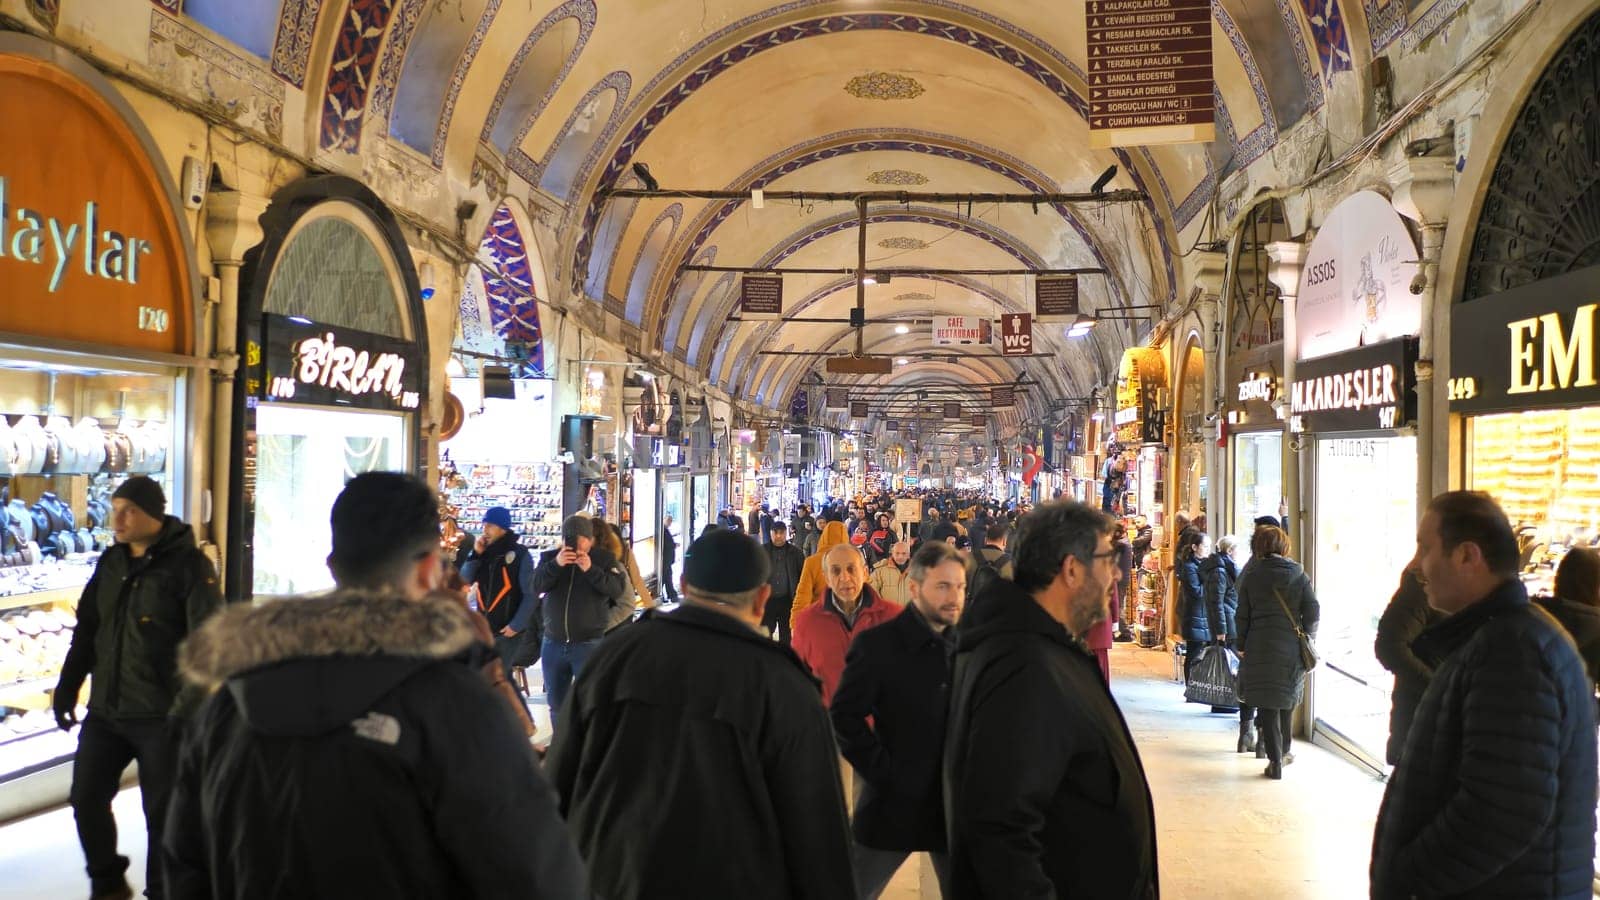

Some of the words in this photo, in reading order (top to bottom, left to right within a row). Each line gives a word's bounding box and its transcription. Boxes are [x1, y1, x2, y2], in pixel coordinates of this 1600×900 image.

[1104, 14, 1136, 26] CEVAHİR
[1136, 11, 1175, 23] BEDESTENİ
[1105, 29, 1135, 40] RESSAM
[1135, 26, 1181, 38] BASMACILAR
[1181, 26, 1194, 35] SK.
[1105, 43, 1149, 54] TAKKECİLER
[1150, 43, 1162, 52] SK.
[1106, 57, 1142, 69] TERZİBAŞI
[1143, 55, 1171, 67] ARALIĞI
[1172, 55, 1184, 65] SK.
[1106, 73, 1135, 84] SANDAL
[1136, 70, 1175, 82] BEDESTENİ
[1107, 86, 1144, 98] ESNAFLAR
[1145, 83, 1176, 95] DERNEĞİ
[1107, 101, 1146, 113] SORGUÇLU
[1147, 99, 1162, 110] HAN
[1167, 99, 1179, 109] WC
[1108, 116, 1132, 128] ÇUKUR
[1307, 259, 1336, 287] ASSOS
[138, 306, 169, 333] 120
[947, 317, 963, 328] CAFE
[1004, 334, 1030, 347] WC
[1290, 364, 1396, 413] M.KARDEŞLER
[1447, 377, 1477, 400] 149
[1379, 406, 1396, 428] 147
